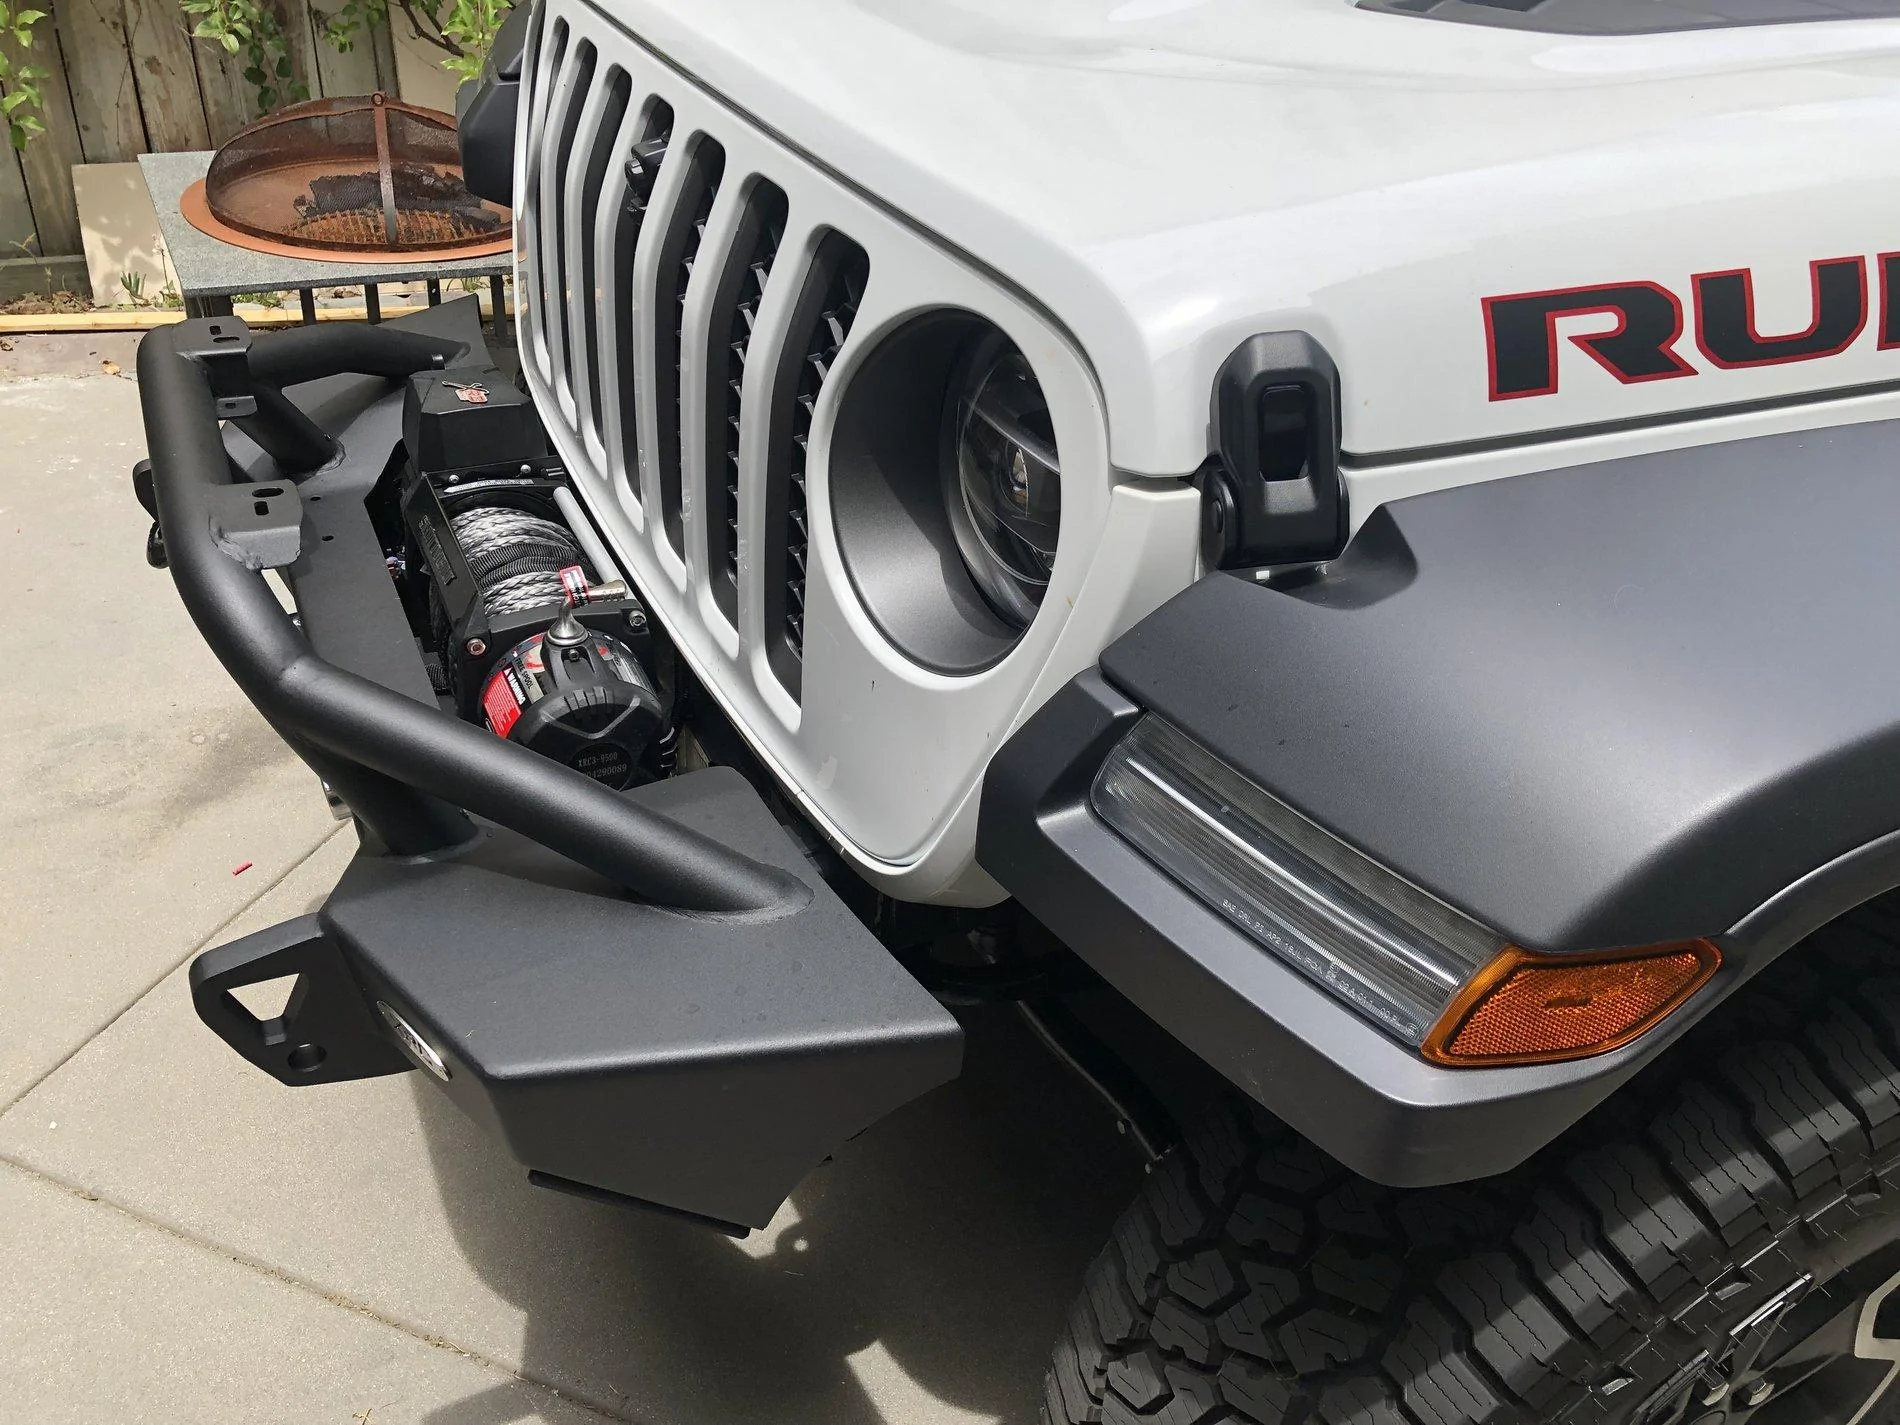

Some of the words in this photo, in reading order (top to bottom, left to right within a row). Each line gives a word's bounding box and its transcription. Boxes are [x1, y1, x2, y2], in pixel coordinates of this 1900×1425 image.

[1481, 251, 1900, 402] RU
[507, 672, 526, 705] WARNING
[521, 671, 534, 690] SPOOL
